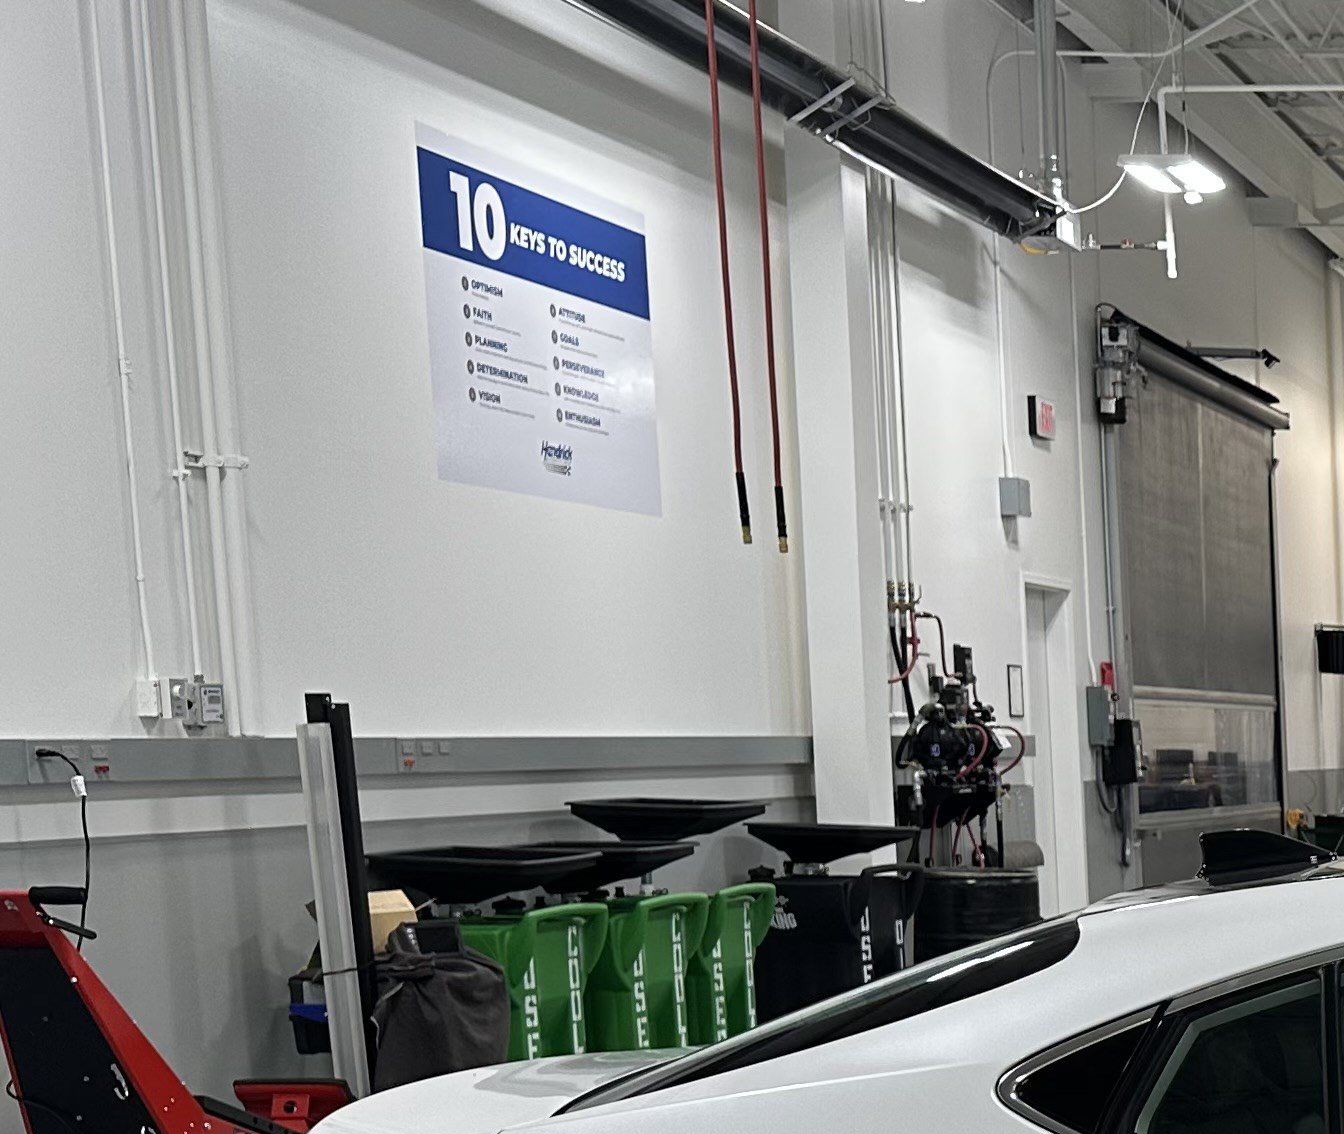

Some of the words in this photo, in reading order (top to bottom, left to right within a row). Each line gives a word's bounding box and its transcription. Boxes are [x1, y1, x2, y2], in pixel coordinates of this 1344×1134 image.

[449, 171, 506, 261] 10
[510, 223, 545, 254] KEYS
[548, 236, 567, 261] TO
[569, 244, 626, 282] SUCCESS
[471, 279, 503, 298] OPTIMISM
[473, 307, 492, 321] FAITH
[475, 335, 508, 353] PLANNING
[560, 332, 579, 347] GOALS
[476, 362, 528, 384] DETERMINATION
[561, 359, 605, 378] PERSEVERANCE
